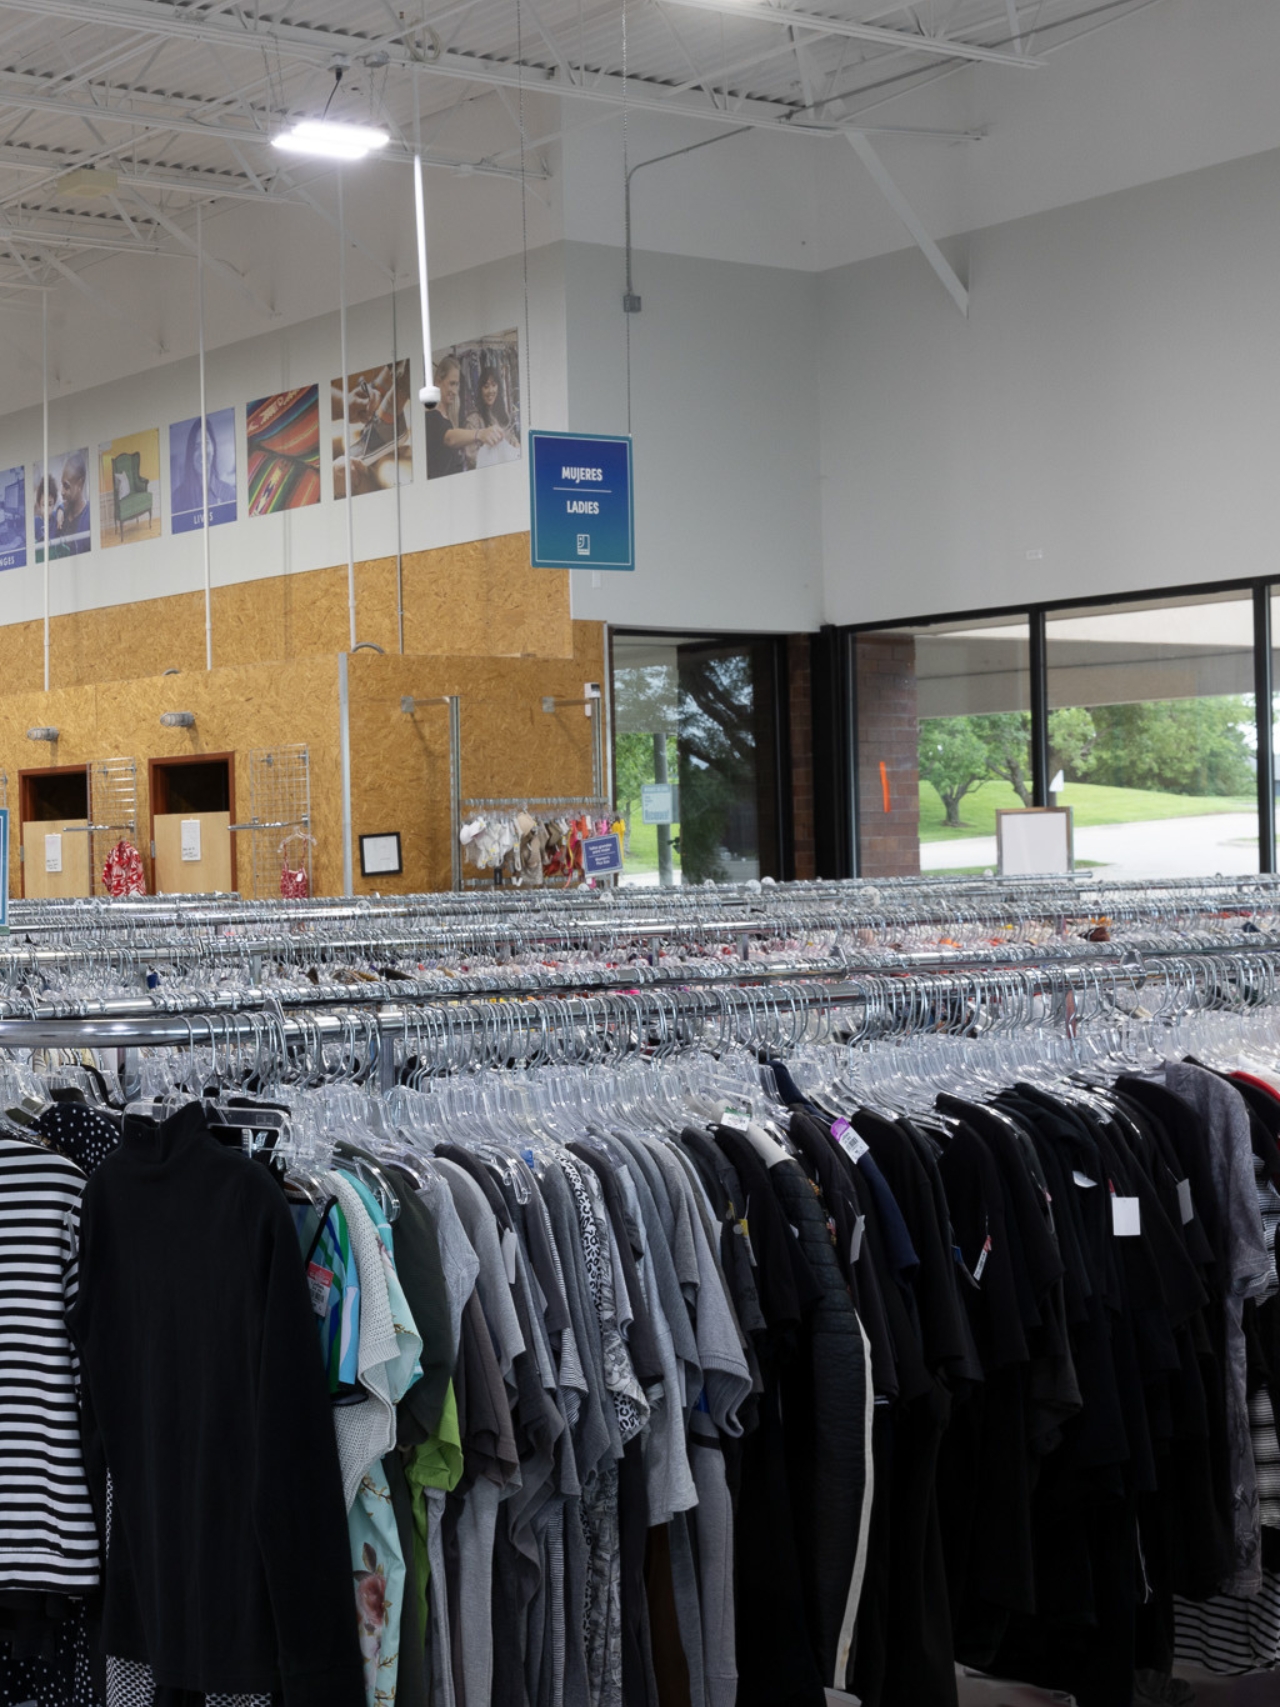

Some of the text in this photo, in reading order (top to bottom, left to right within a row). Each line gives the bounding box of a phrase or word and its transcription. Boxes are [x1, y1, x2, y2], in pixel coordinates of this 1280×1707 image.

[561, 466, 603, 484] MUJERES
[566, 500, 600, 515] LADIES
[193, 511, 214, 525] LIVS
